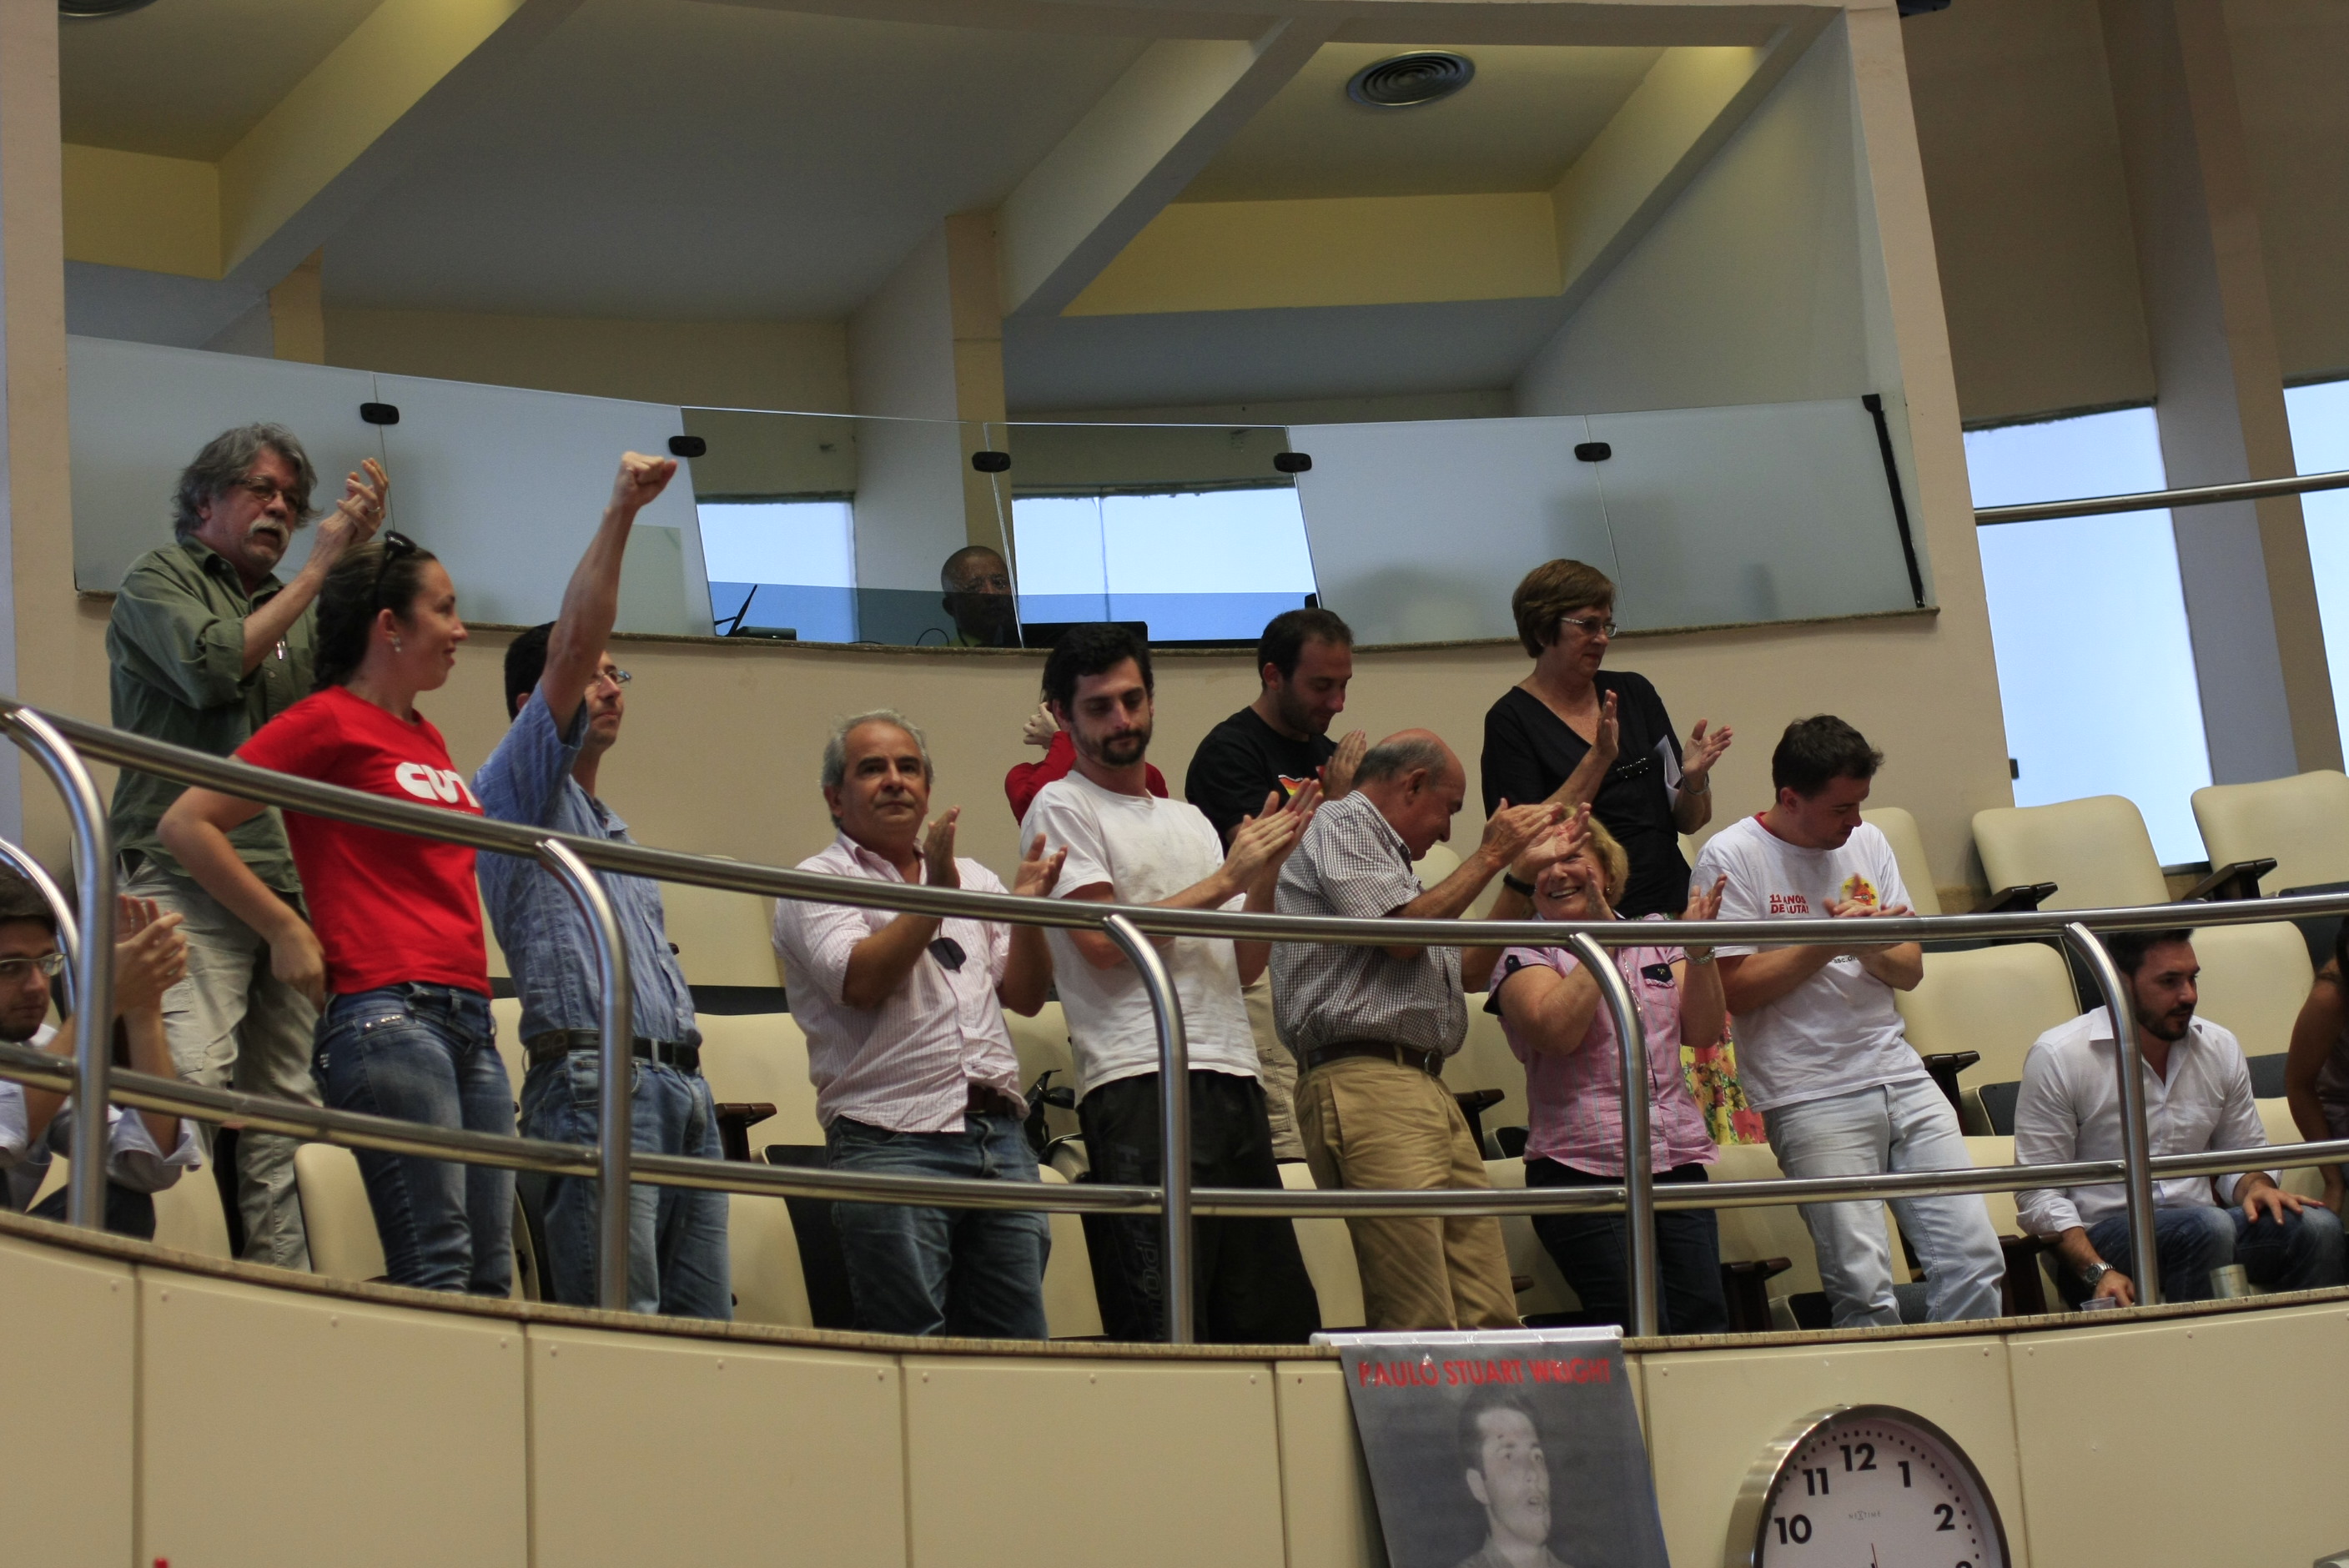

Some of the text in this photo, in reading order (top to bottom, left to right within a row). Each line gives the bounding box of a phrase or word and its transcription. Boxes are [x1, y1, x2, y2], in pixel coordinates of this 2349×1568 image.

[395, 761, 481, 808] CUT
[1769, 894, 1782, 903] 11
[1771, 904, 1785, 914] DE
[1357, 1358, 1611, 1387] PAULO STUART WRIGHT
[1839, 1442, 1877, 1472] 12
[1802, 1467, 1829, 1496] 11
[1898, 1460, 1912, 1488] 1
[1773, 1514, 1812, 1545] 10
[1934, 1503, 1955, 1532] 2
